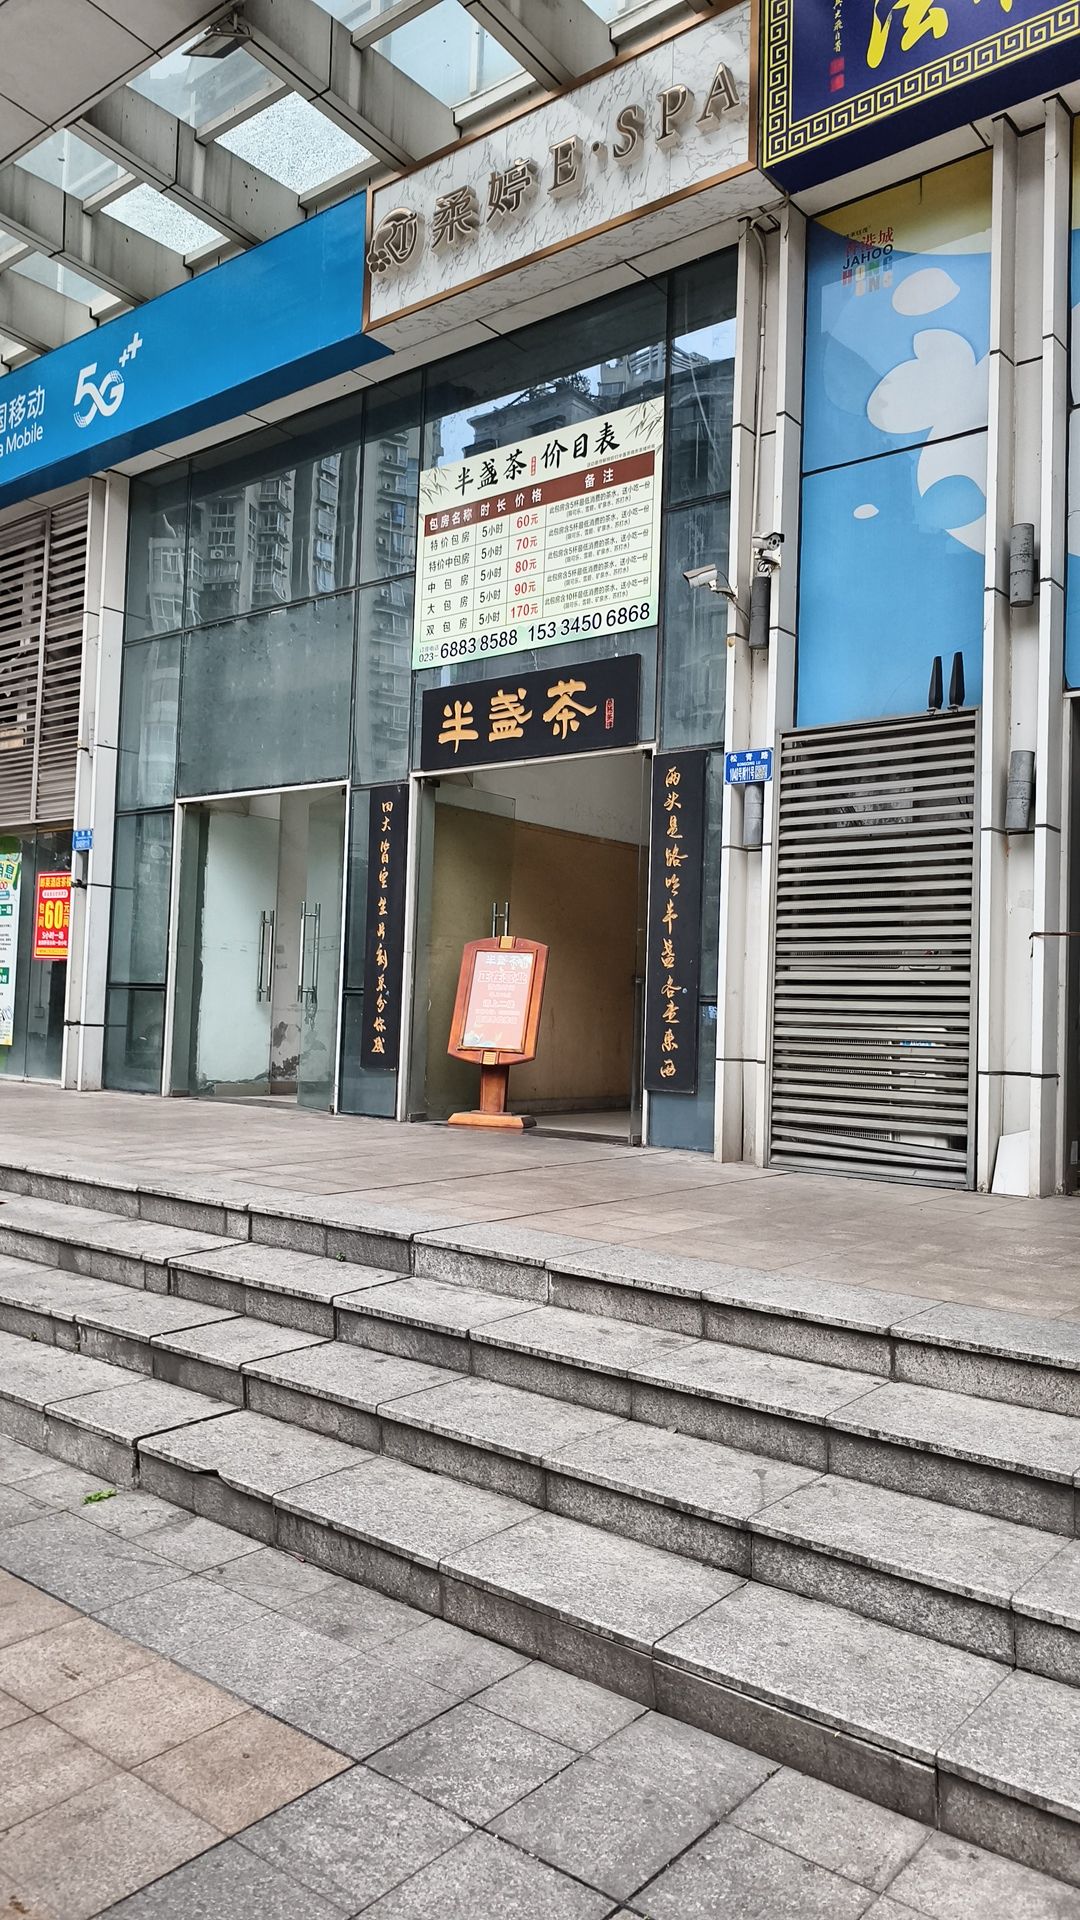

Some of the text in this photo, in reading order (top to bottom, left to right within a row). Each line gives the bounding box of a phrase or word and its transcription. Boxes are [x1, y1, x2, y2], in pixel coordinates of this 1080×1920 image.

[432, 157, 531, 250] 柔婷
[843, 244, 893, 269] JAHOO
[6, 423, 44, 454] Mobile
[455, 448, 527, 496] 半盏茶
[541, 422, 621, 469] 价目表
[430, 468, 614, 530] 包房名称 时长 价格 备注
[430, 513, 539, 551] 特价包房 5小时 60元
[429, 536, 538, 572] 特价中包房 5小时 70元
[480, 567, 502, 582] 5小时
[515, 558, 537, 574] 80元
[479, 589, 501, 603] 5小时
[514, 581, 536, 596] 90元
[440, 637, 476, 659] 6883
[480, 628, 518, 651] 8588
[528, 622, 556, 642] 153
[560, 612, 602, 636] 3450
[606, 602, 650, 628] 6868
[479, 611, 500, 625] 5小时
[511, 603, 538, 619] 170元
[438, 678, 597, 753] 半盏茶
[730, 751, 769, 763] 松青路
[45, 900, 64, 929] 60
